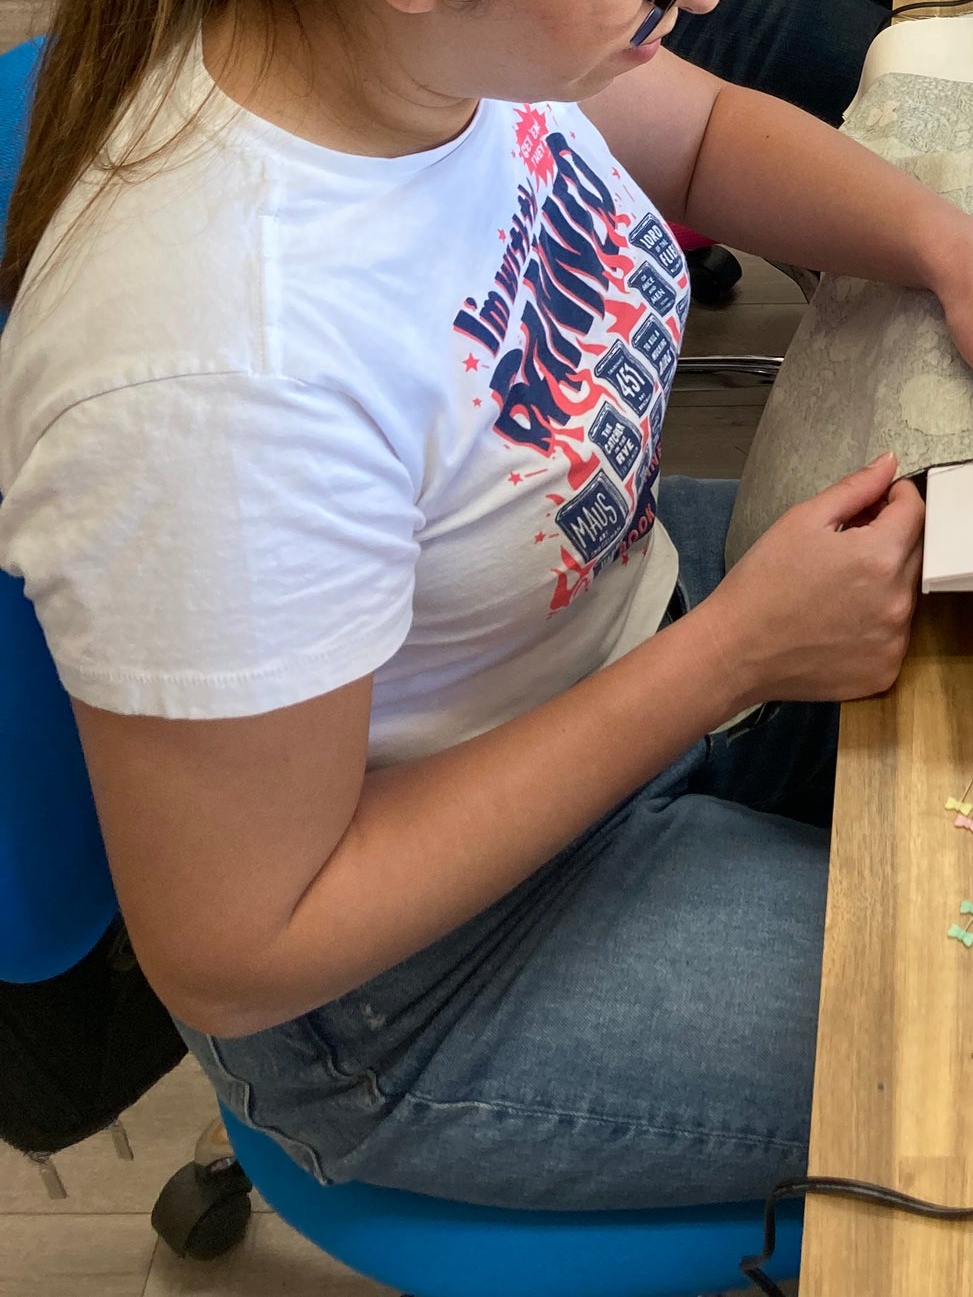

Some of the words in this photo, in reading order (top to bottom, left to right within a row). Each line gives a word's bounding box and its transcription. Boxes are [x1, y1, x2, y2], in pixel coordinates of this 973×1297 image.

[640, 224, 663, 250] LORD
[453, 290, 510, 359] I'm
[494, 213, 530, 306] with
[487, 131, 618, 458] BANNED
[650, 288, 666, 305] MEN
[616, 362, 645, 397] 451
[601, 422, 613, 438] THE
[604, 422, 626, 455] CATCHER
[615, 438, 635, 465] RYE
[570, 492, 618, 549] MAUS
